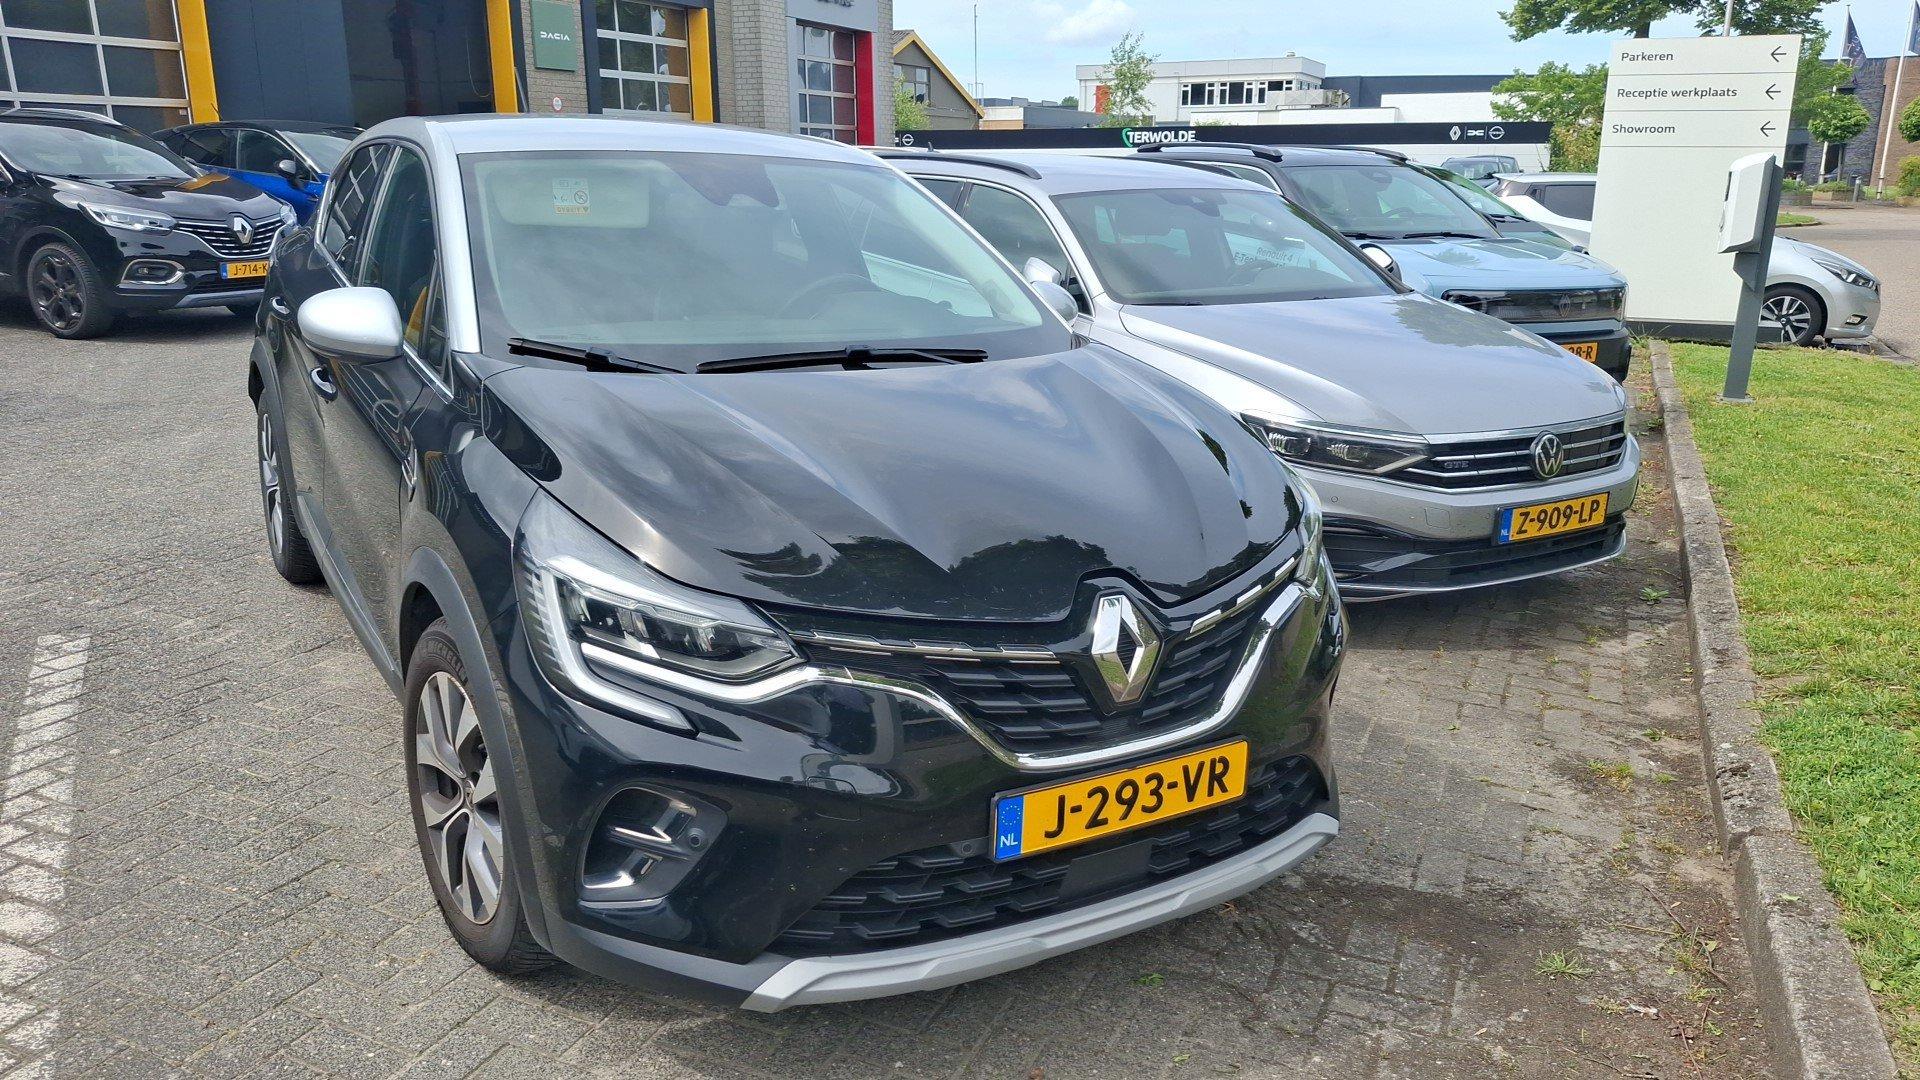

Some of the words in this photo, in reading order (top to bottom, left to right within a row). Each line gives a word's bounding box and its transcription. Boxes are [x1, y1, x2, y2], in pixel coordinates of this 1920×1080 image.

[540, 31, 570, 41] DACIA
[1621, 52, 1674, 61] Parkeren
[1617, 88, 1668, 99] Receptie
[1671, 87, 1738, 99] werkplaats
[1612, 124, 1676, 134] Showroom
[1127, 130, 1196, 144] TERWOLDE
[1516, 499, 1601, 535] Z-909-LP
[1000, 833, 1018, 848] NL
[1044, 755, 1230, 839] J-293-VR
